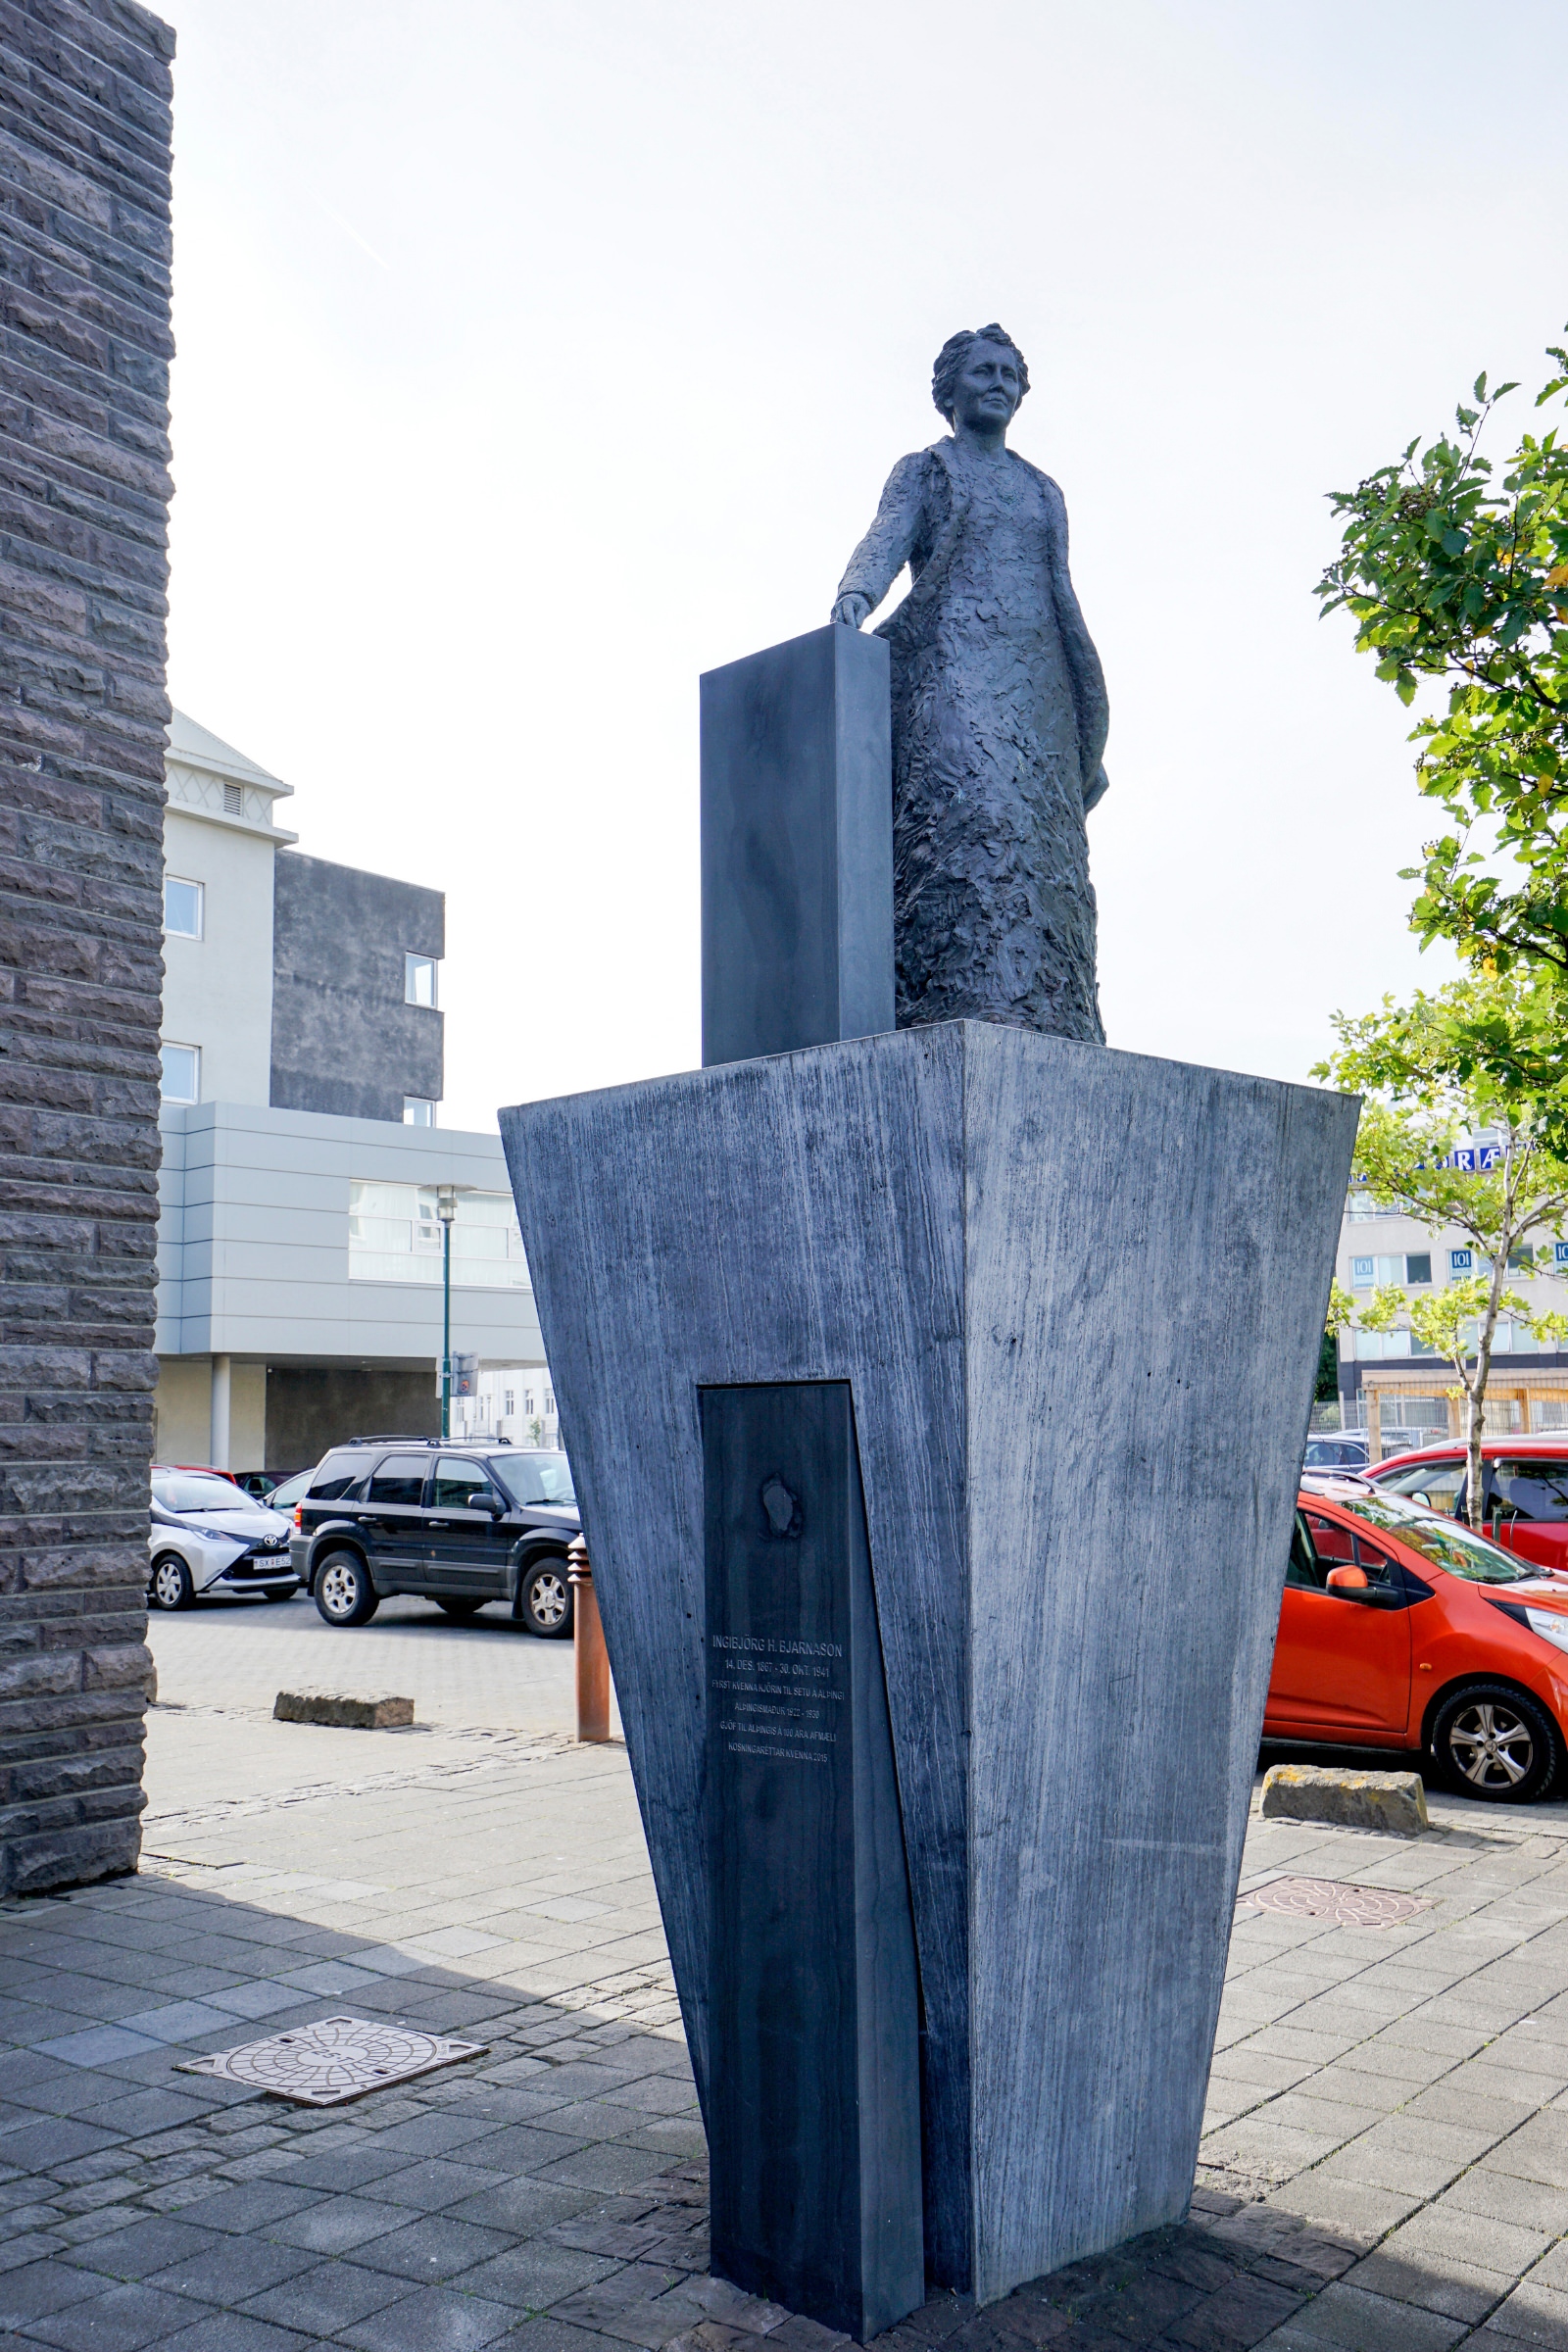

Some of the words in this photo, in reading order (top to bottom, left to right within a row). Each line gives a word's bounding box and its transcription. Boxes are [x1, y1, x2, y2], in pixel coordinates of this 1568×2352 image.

[259, 1559, 270, 1568] SX
[712, 1634, 765, 1651] INGIBJÖRG
[767, 1639, 777, 1652] H.
[779, 1640, 842, 1657] BJARNASON
[725, 1659, 735, 1669] 14.
[737, 1660, 754, 1671] DES.
[757, 1662, 772, 1672] 1867
[779, 1663, 790, 1674] 30.
[792, 1664, 809, 1676] OKT.
[813, 1666, 829, 1678] 1941
[711, 1680, 731, 1689] FYRST
[732, 1681, 759, 1692] KVENNA
[759, 1683, 782, 1694] KJÖRIN
[782, 1686, 793, 1695] TIL
[794, 1687, 810, 1696] SETU
[817, 1689, 845, 1700] ALÞINGI
[734, 1702, 785, 1715] ALÞINGISMAÐUR
[720, 1720, 737, 1731] GJÖF
[738, 1722, 747, 1732] TIL
[748, 1724, 776, 1736] ALÞINGIS
[729, 1742, 785, 1757] KOSNINGARÉTTAR
[785, 1749, 812, 1760] KVENNA
[813, 1753, 827, 1763] 2015
